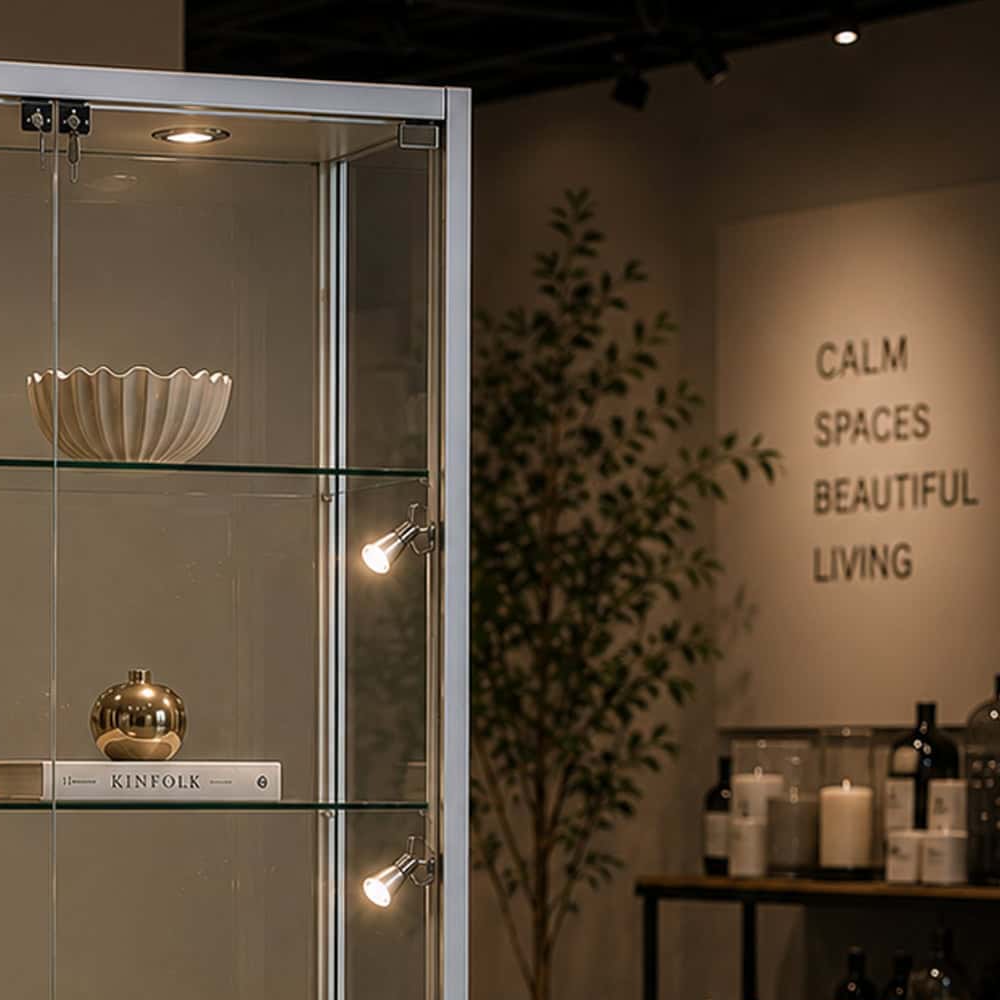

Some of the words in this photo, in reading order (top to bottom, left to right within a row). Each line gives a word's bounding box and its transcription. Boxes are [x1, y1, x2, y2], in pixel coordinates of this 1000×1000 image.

[816, 335, 908, 380] CALM
[814, 403, 931, 447] SPACES
[814, 469, 979, 515] BEAUTIFUL
[813, 542, 912, 583] LIVING
[111, 774, 201, 790] KINFOLK
